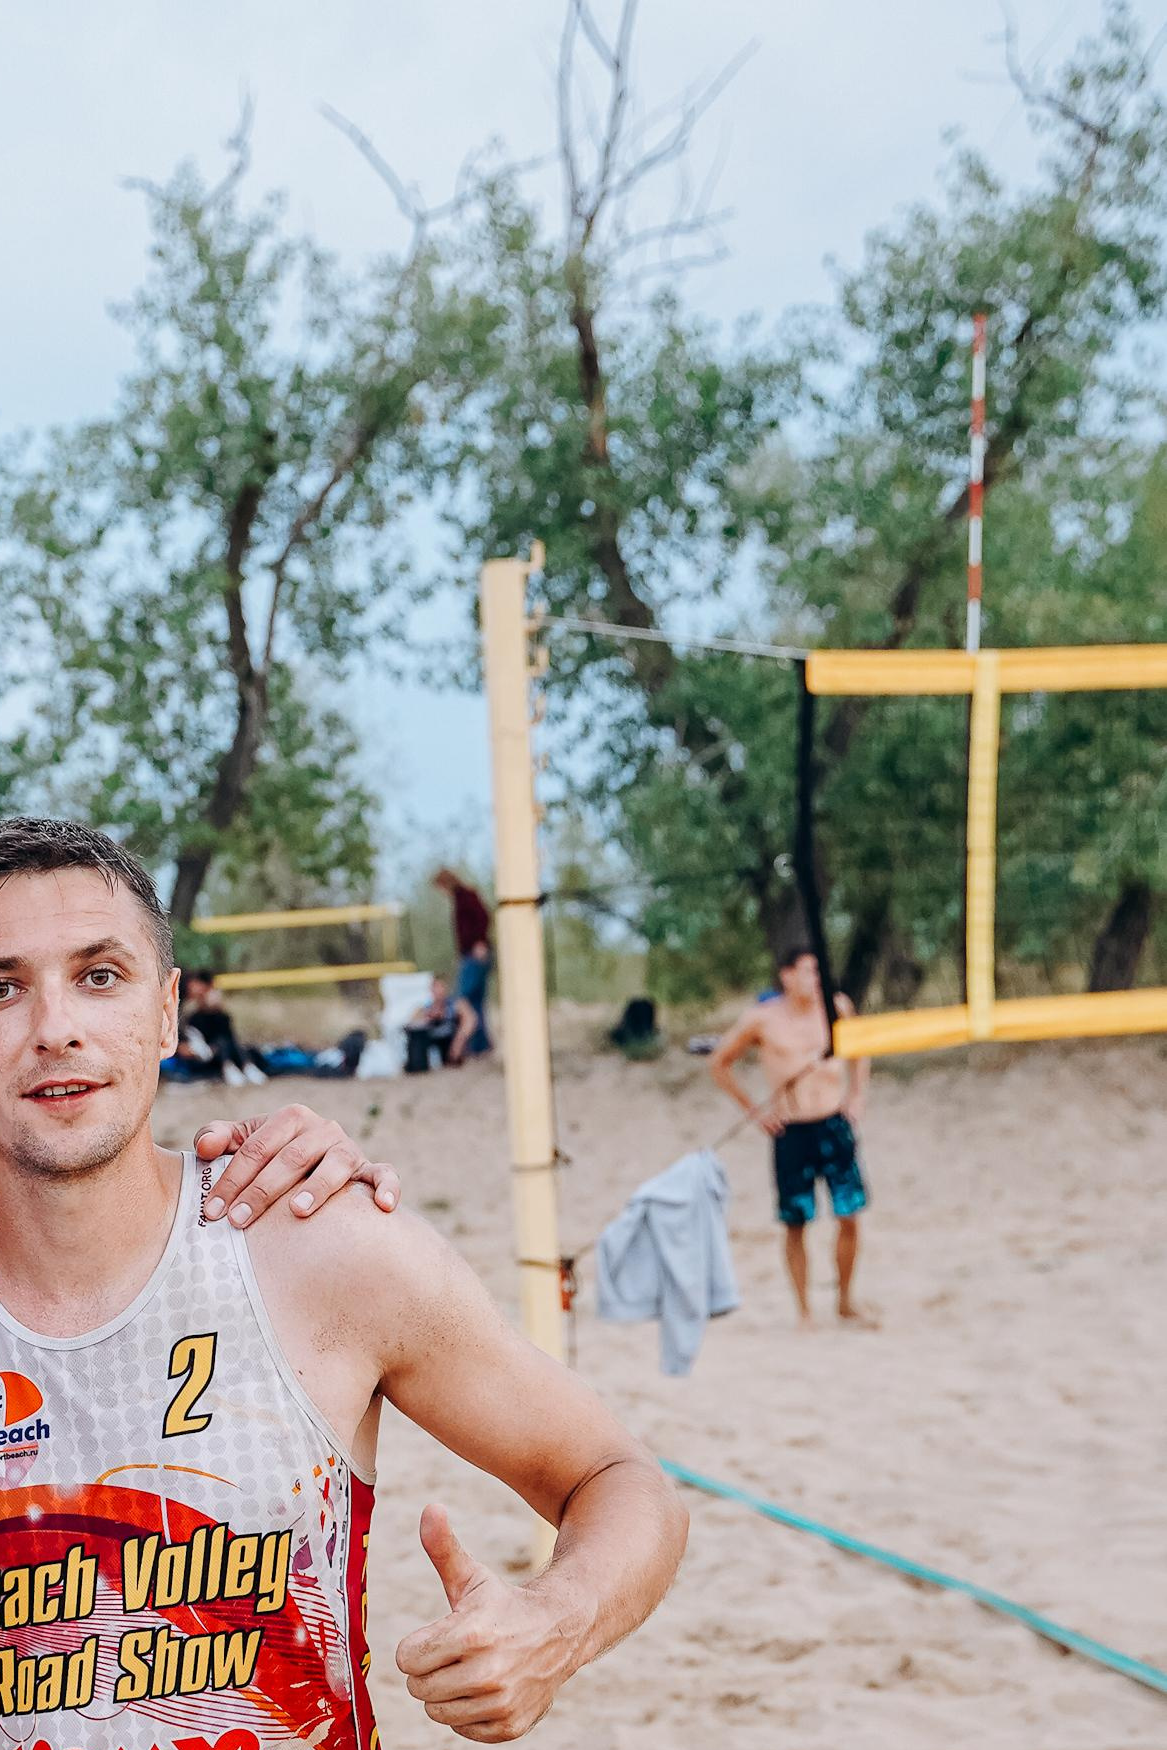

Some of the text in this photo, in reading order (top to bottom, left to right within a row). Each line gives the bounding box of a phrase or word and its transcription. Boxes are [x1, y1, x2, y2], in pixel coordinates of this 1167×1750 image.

[198, 1167, 212, 1227] FAT.ORG
[162, 1332, 218, 1438] 2
[121, 1523, 294, 1615] Volley
[112, 1623, 263, 1703] Show
